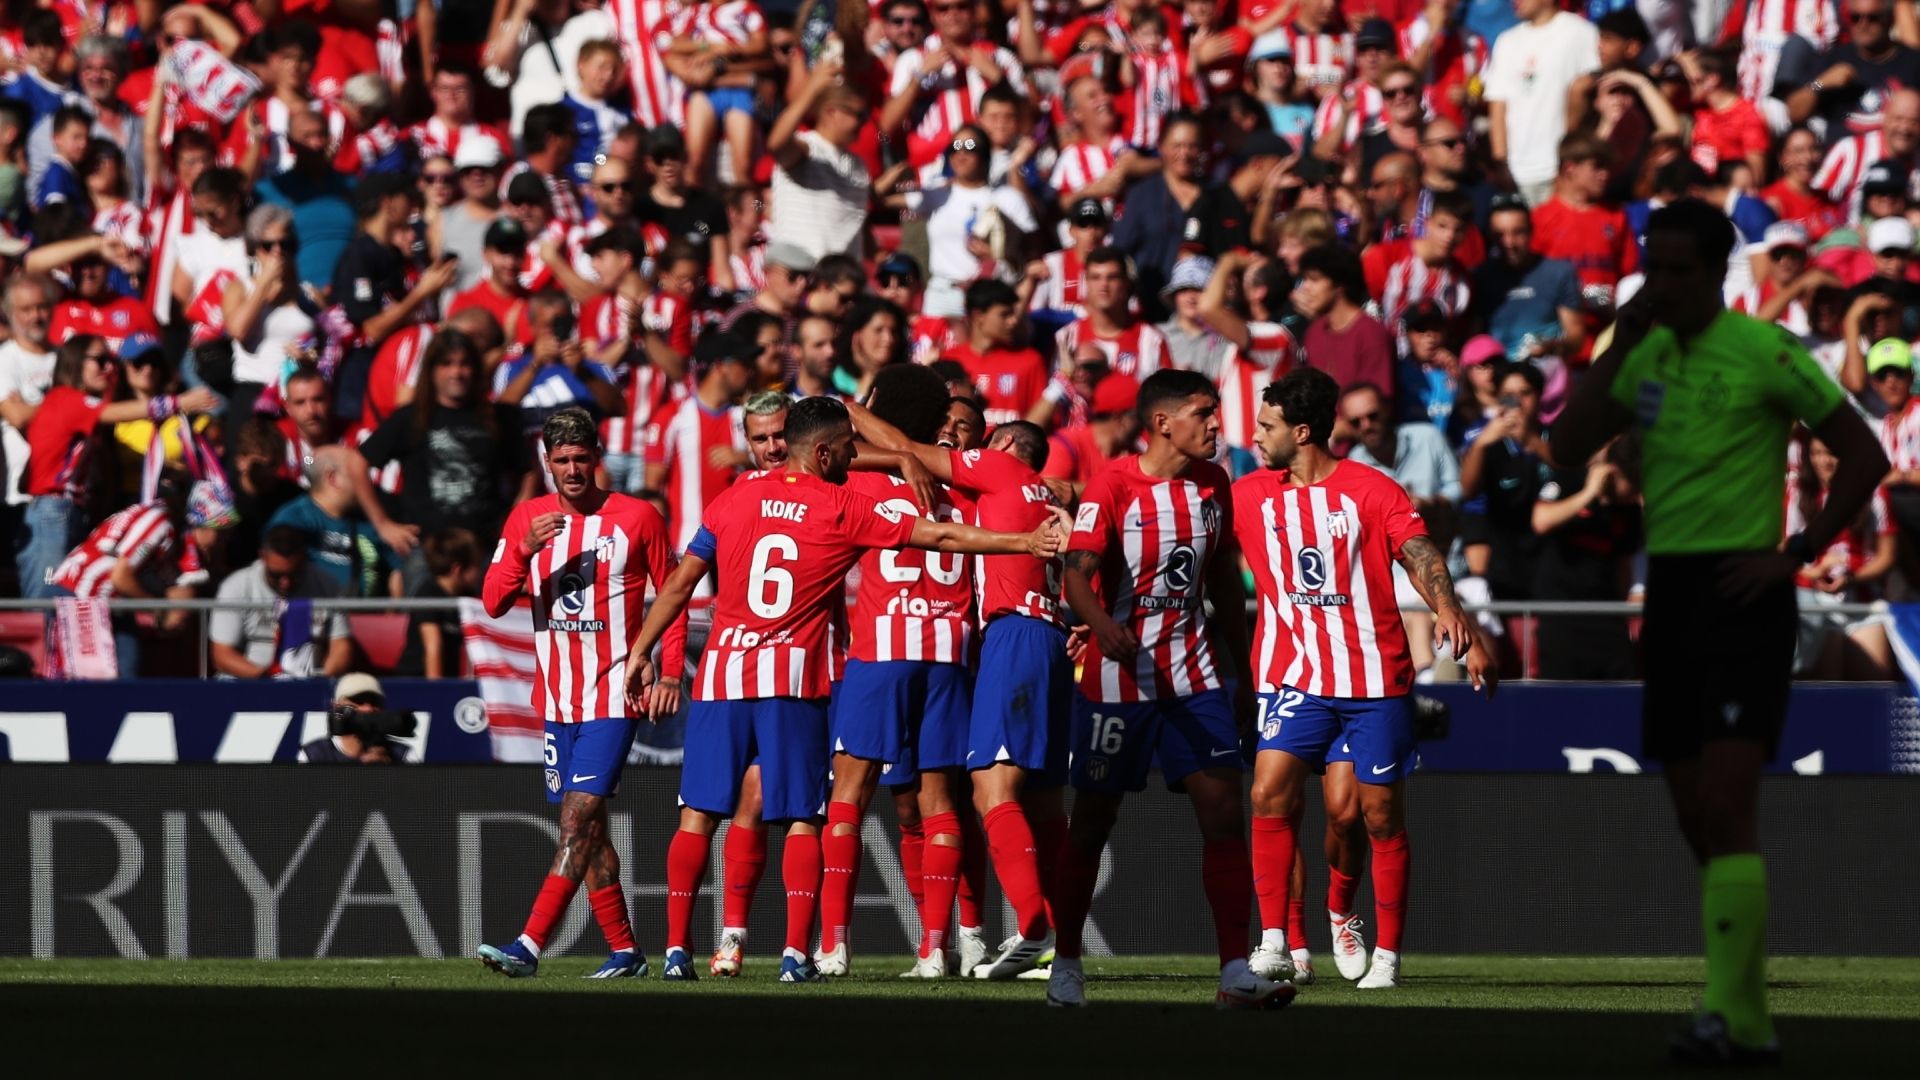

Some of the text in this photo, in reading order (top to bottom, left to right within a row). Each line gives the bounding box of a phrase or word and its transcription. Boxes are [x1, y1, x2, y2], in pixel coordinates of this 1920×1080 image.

[761, 499, 808, 523] KOKE
[747, 533, 798, 619] 6
[887, 587, 929, 617] ria
[1327, 595, 1347, 605] AIR
[584, 621, 603, 631] AIR
[718, 624, 760, 648] ria
[1091, 712, 1125, 754] 16
[545, 732, 558, 766] 5
[28, 809, 728, 961] RIYADH
